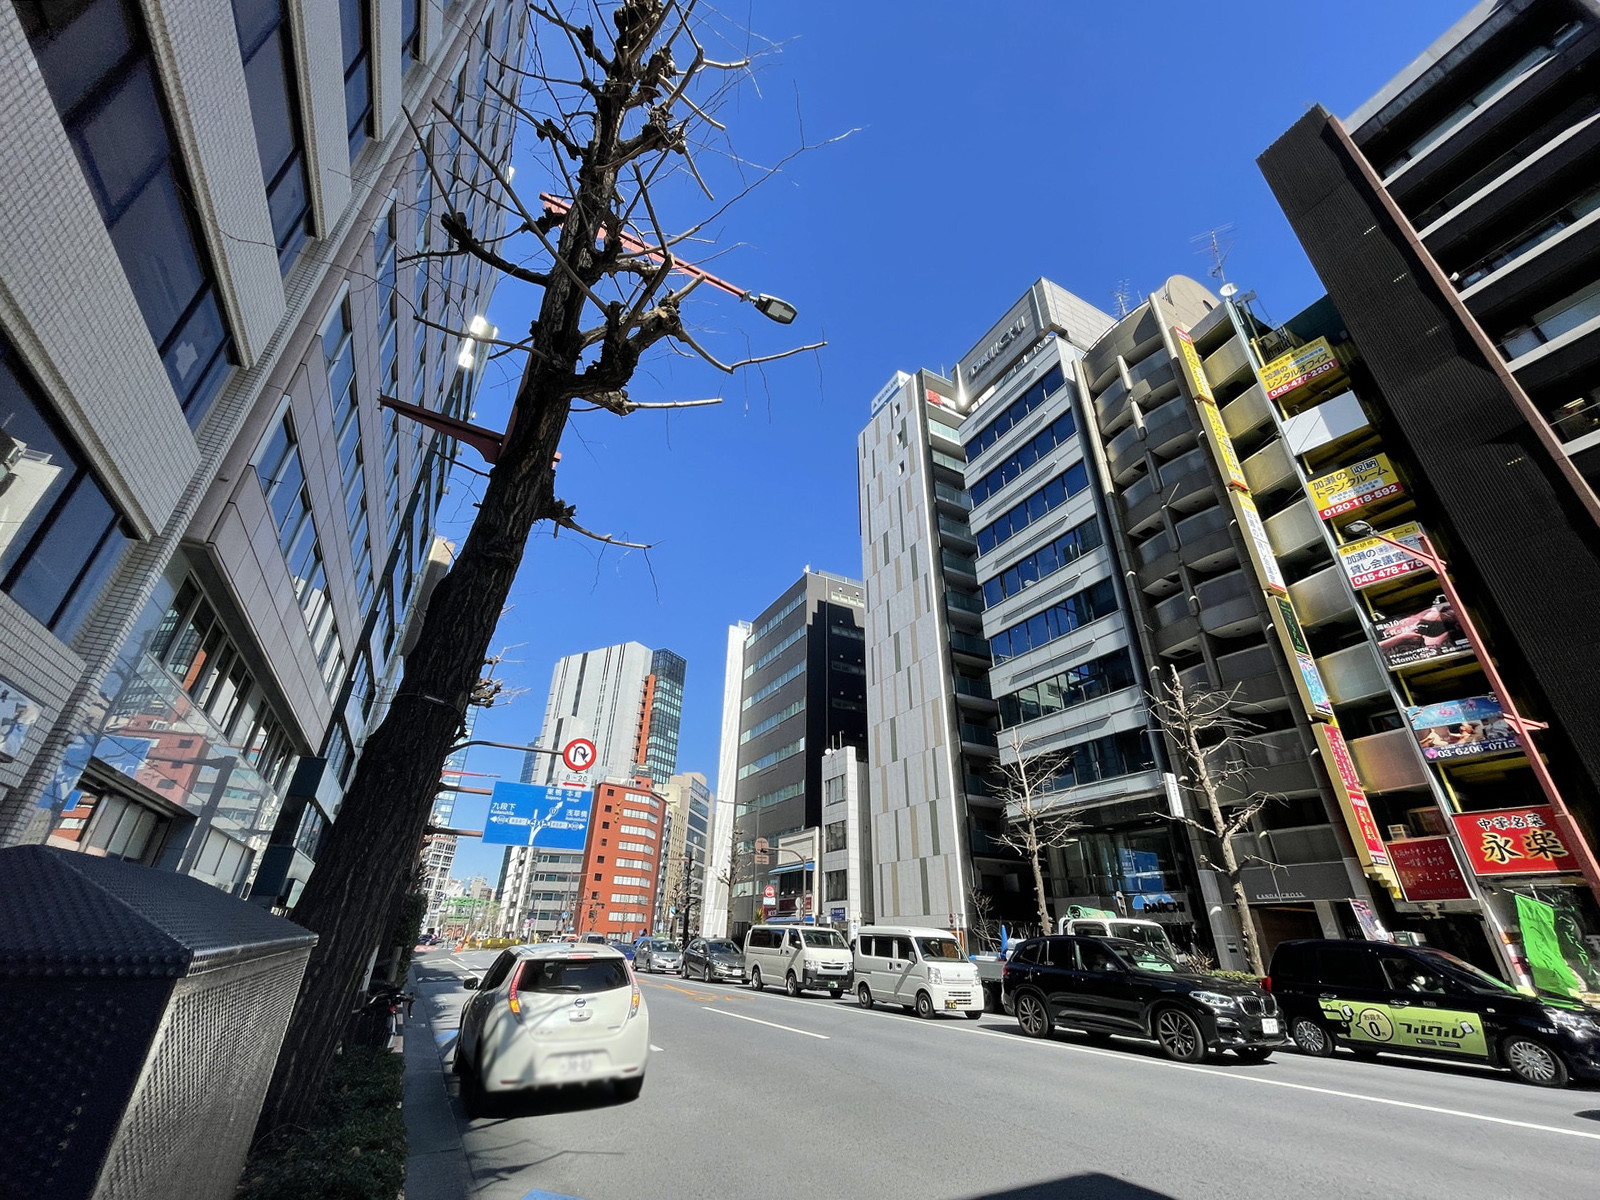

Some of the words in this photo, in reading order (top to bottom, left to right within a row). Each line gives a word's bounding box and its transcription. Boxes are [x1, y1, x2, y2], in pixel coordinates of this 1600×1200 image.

[1267, 352, 1330, 388] レンタルオフィス
[1271, 361, 1335, 397] 045-477-2201
[1351, 458, 1379, 475] 収納
[1312, 471, 1347, 490] 加瀬の
[1316, 467, 1389, 499] トランクルーム
[1323, 485, 1398, 517] 0120-118-592
[1345, 549, 1376, 565] 加瀬の
[1349, 551, 1408, 576] 貸し会議室
[1354, 560, 1424, 585] 045-478-476
[1437, 740, 1516, 758] 03-6206-0715
[492, 802, 517, 811] 九段下
[1477, 813, 1546, 831] 中華名菜
[1480, 828, 1569, 865] 永楽
